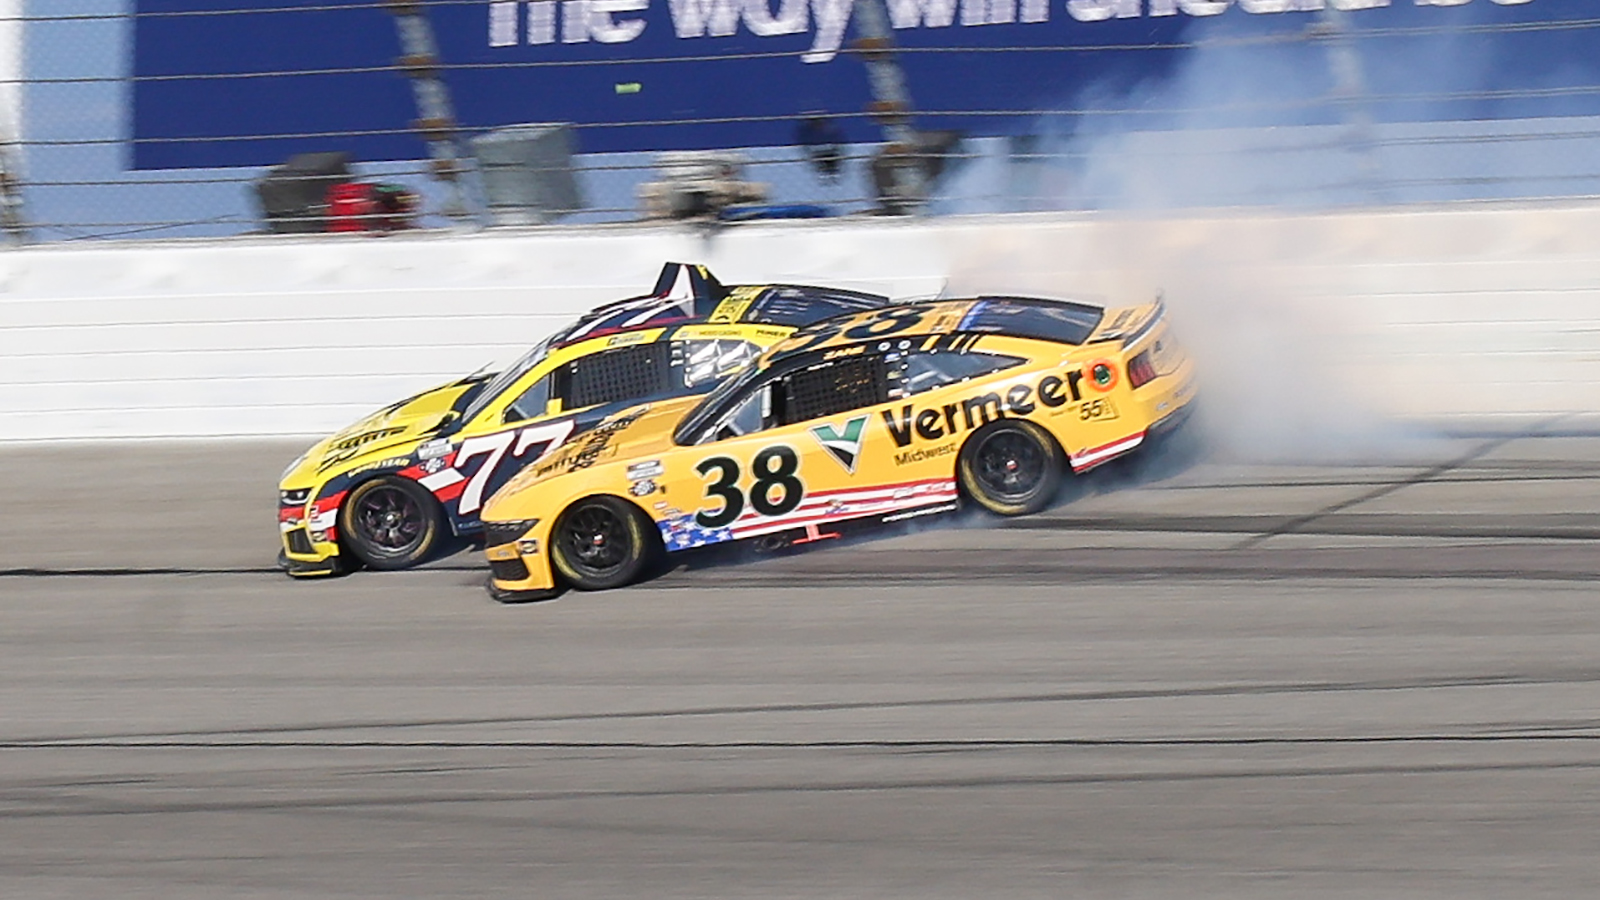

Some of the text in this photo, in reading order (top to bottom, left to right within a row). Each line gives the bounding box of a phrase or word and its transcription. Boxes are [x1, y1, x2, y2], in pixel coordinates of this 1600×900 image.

[882, 367, 1084, 448] Vermeer
[1080, 399, 1102, 421] 55
[453, 419, 575, 515] 77
[695, 444, 803, 528] 38
[893, 443, 957, 467] Midwest
